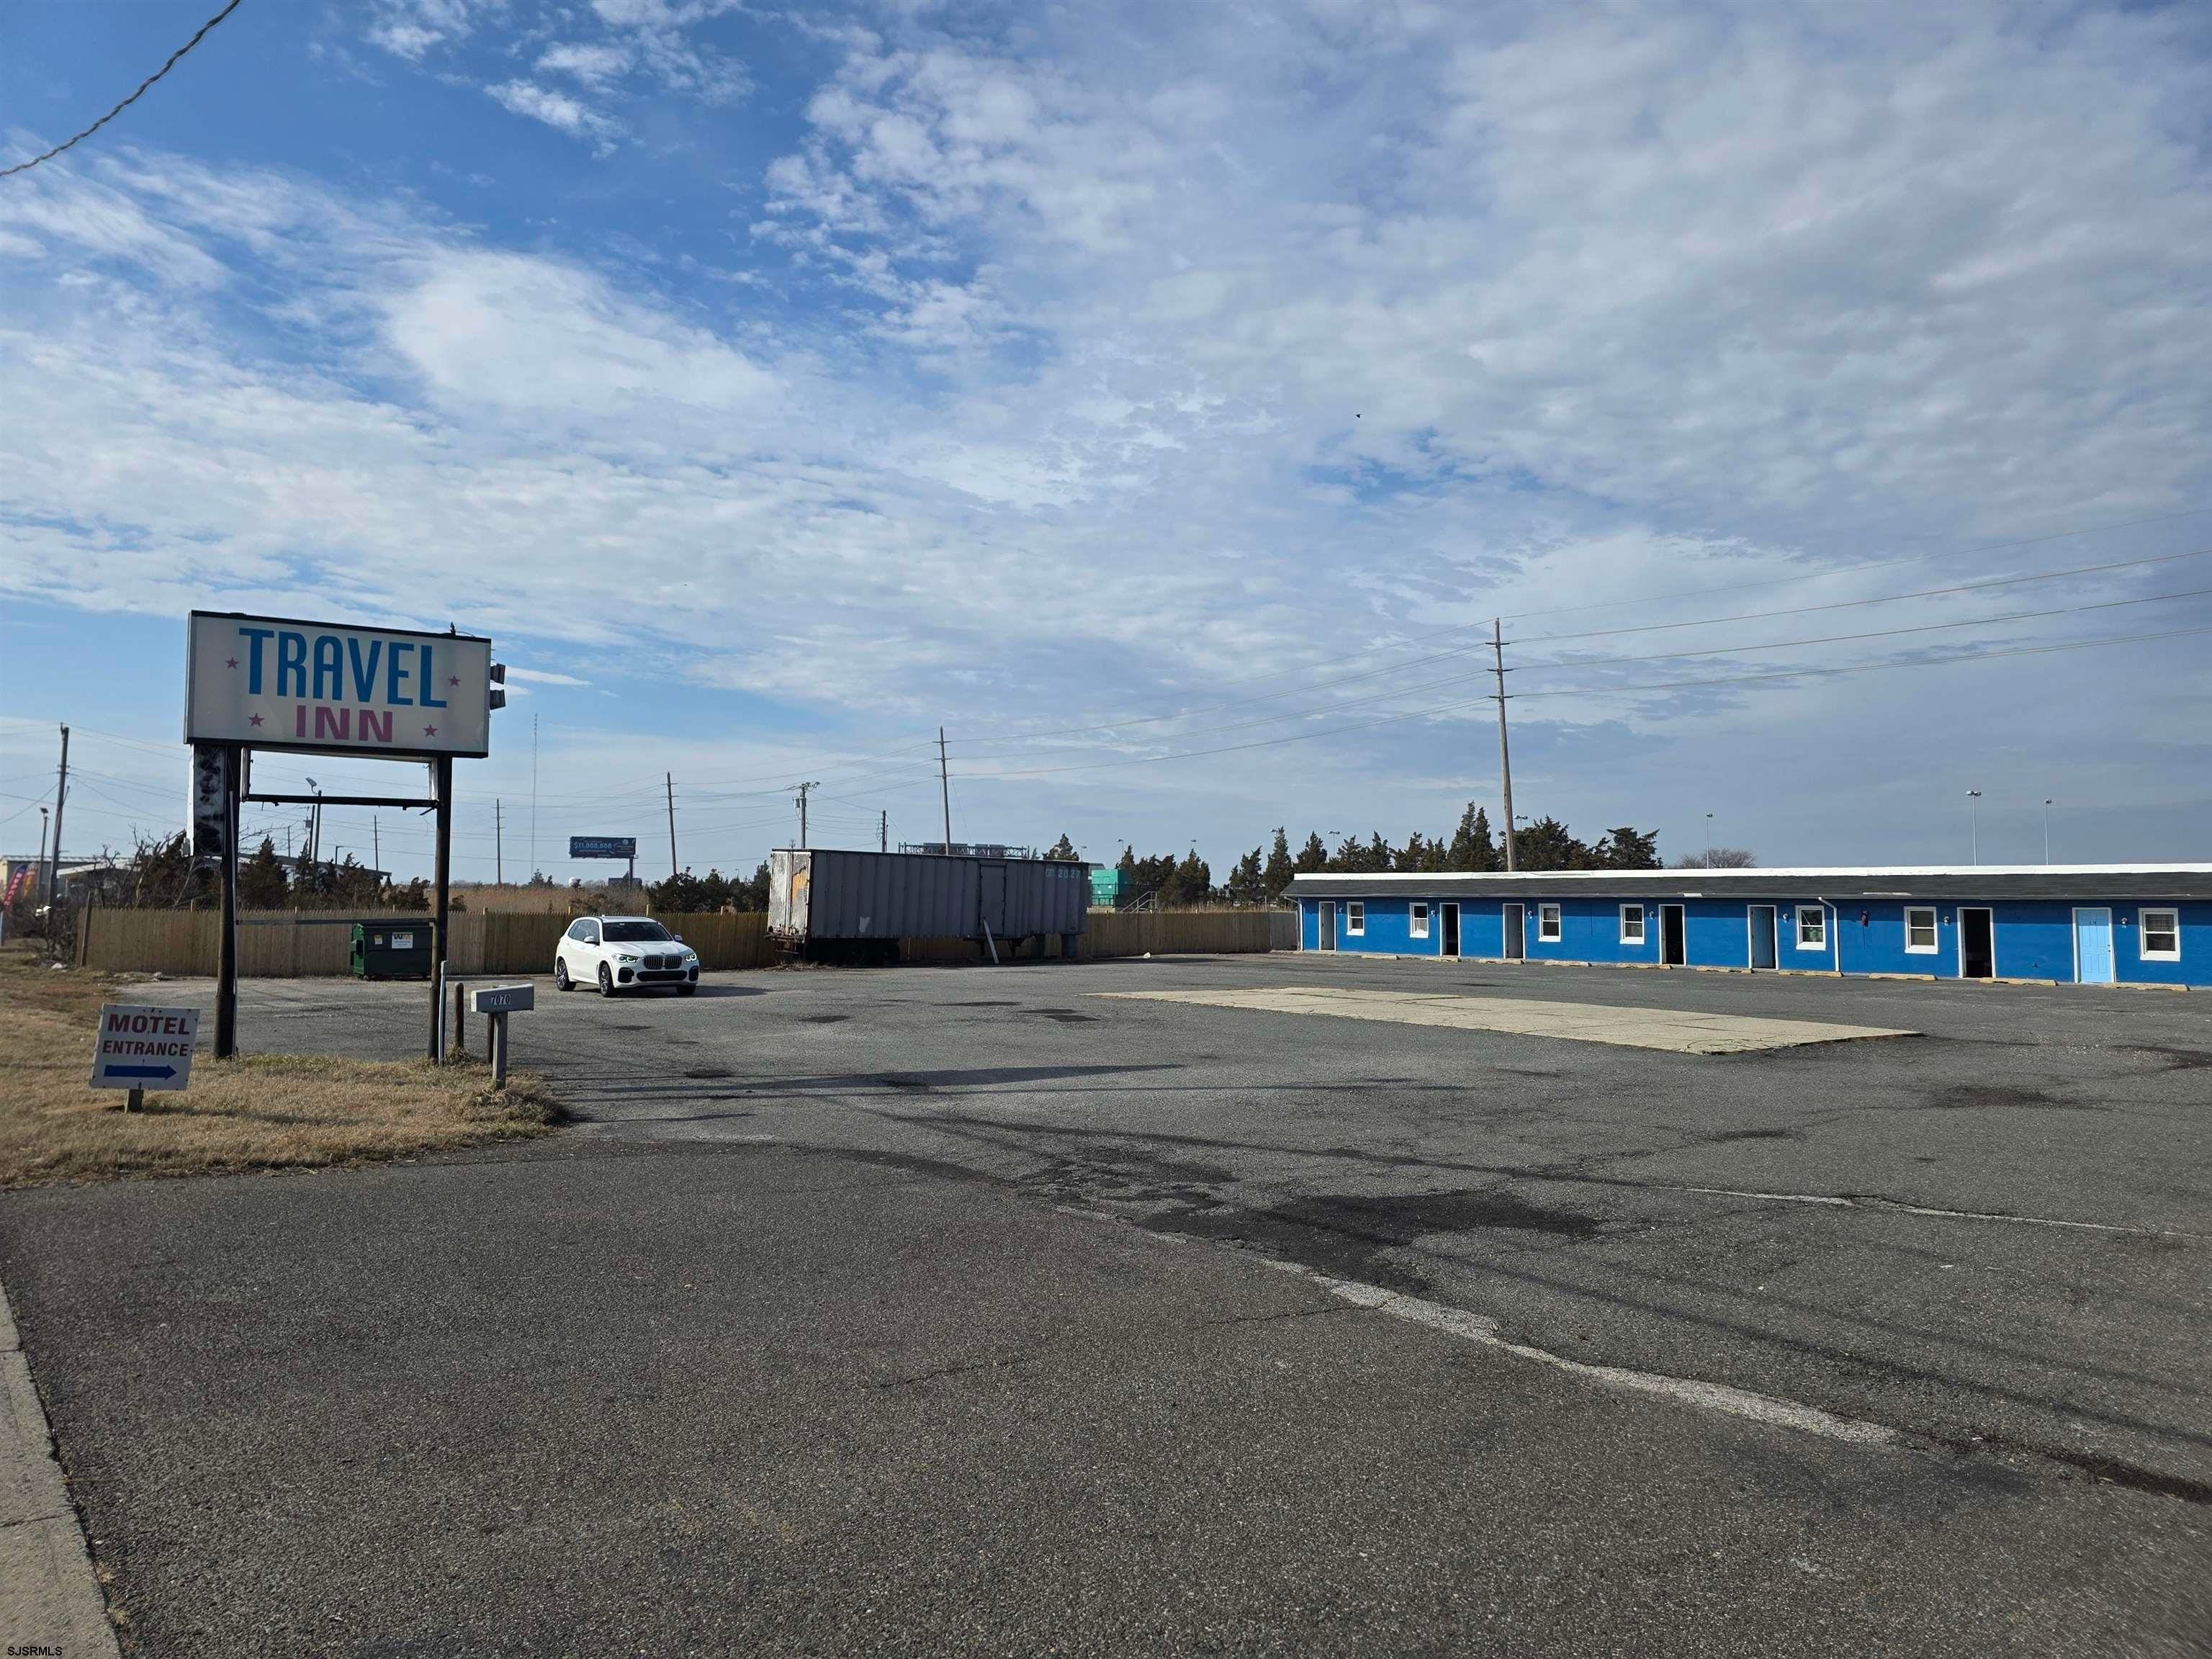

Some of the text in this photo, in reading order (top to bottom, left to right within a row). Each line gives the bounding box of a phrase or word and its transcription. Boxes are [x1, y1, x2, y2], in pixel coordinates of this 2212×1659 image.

[239, 628, 446, 708] TRAVEL
[295, 705, 392, 742] INN
[491, 995, 510, 1005] 7070
[108, 1014, 190, 1035] MOTEL
[102, 1040, 189, 1056] ENTRANCE
